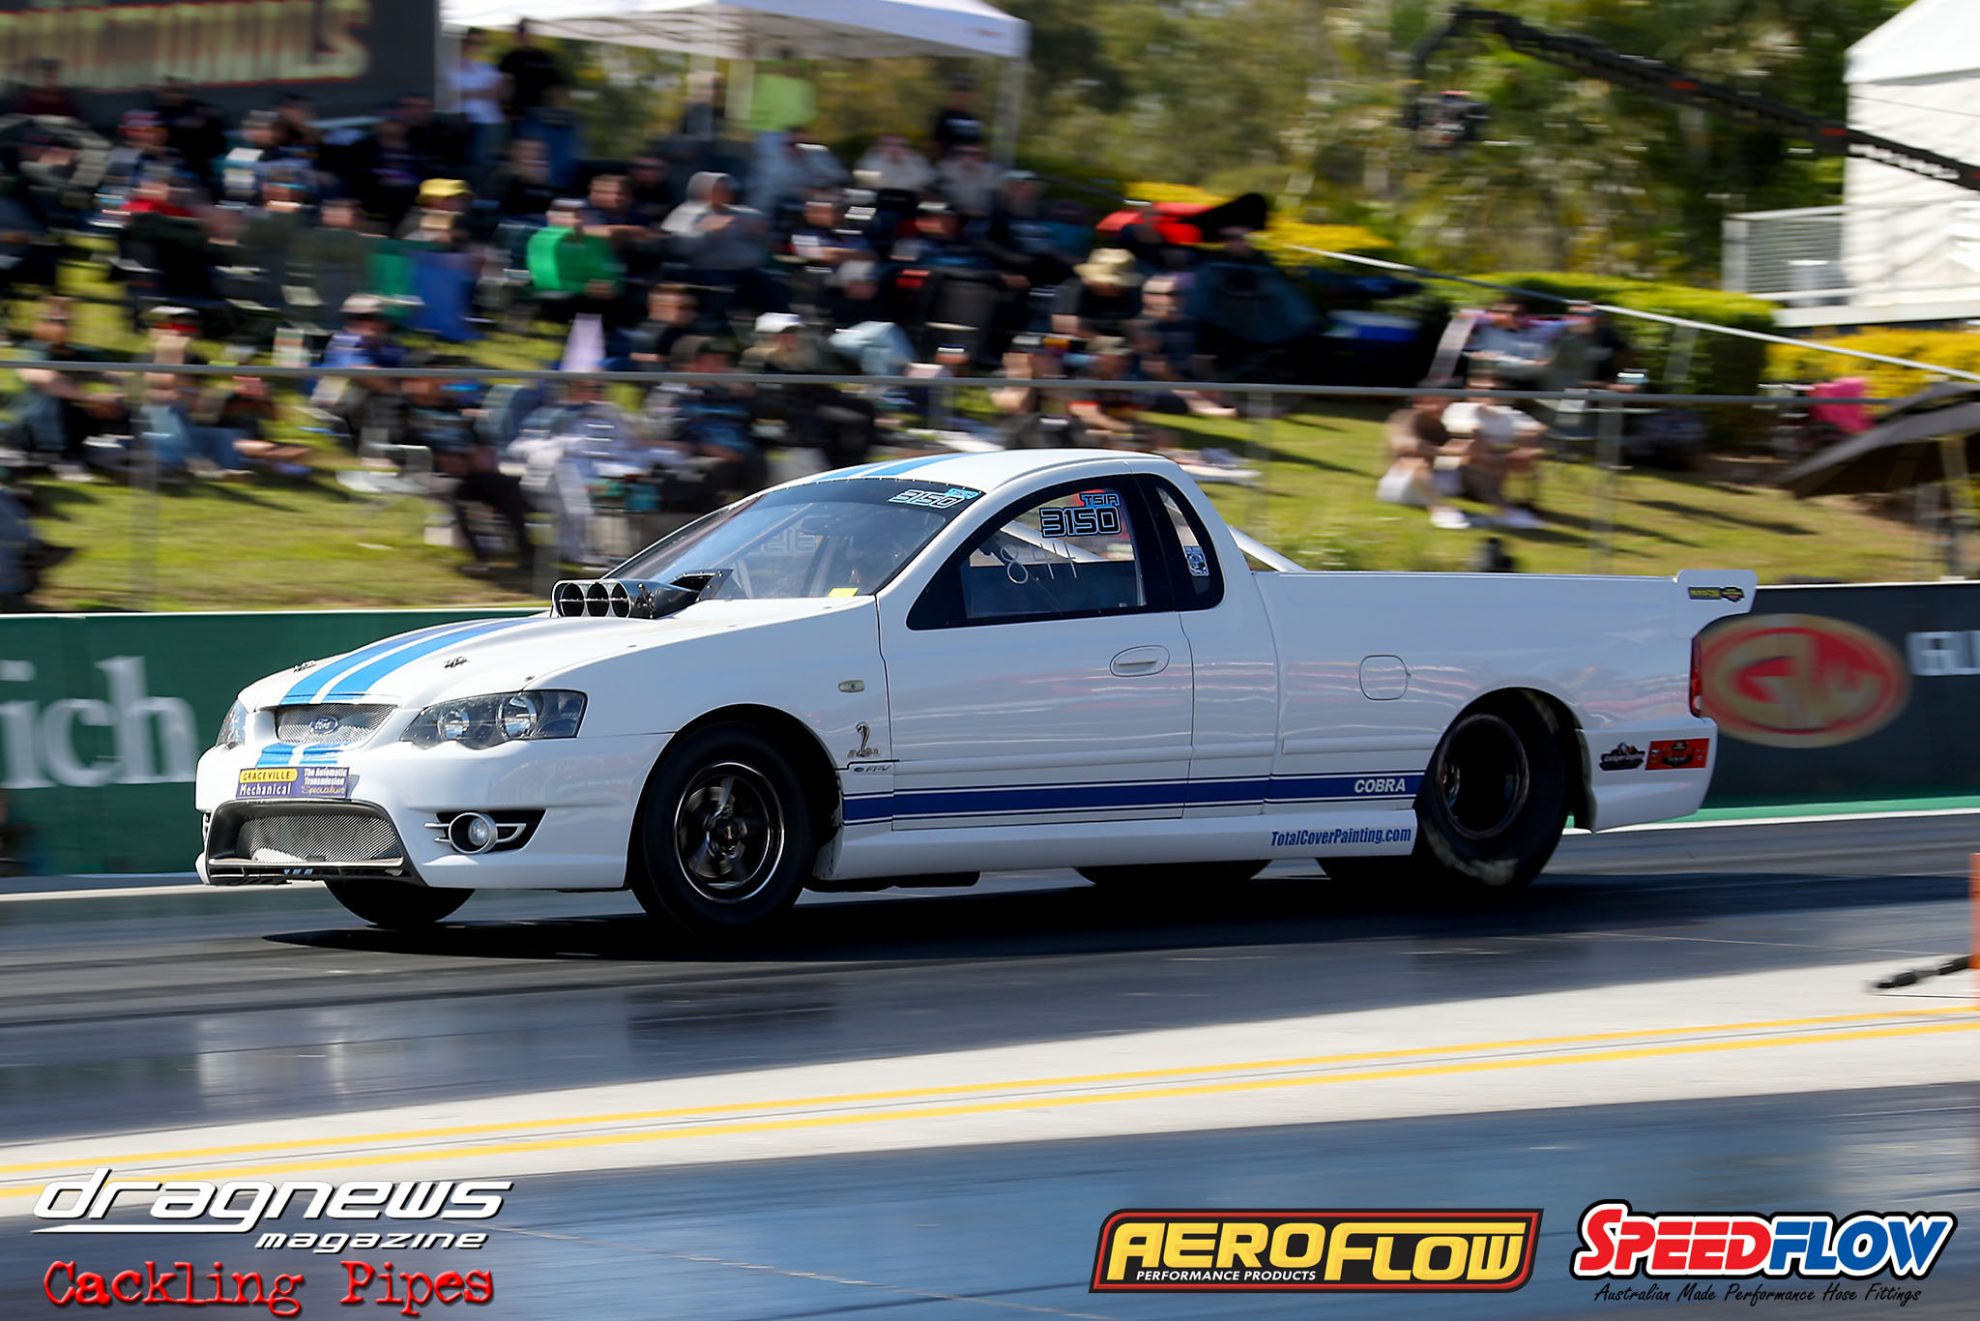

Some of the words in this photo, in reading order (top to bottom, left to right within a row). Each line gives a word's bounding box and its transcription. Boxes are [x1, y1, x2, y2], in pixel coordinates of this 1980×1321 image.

[888, 489, 965, 509] 3150
[1040, 507, 1121, 538] 3150
[243, 770, 290, 782] GRACEVILLE
[239, 782, 292, 796] Mechanical
[1354, 778, 1406, 793] COBRA
[1271, 827, 1412, 847] TotalCoverPainting.com
